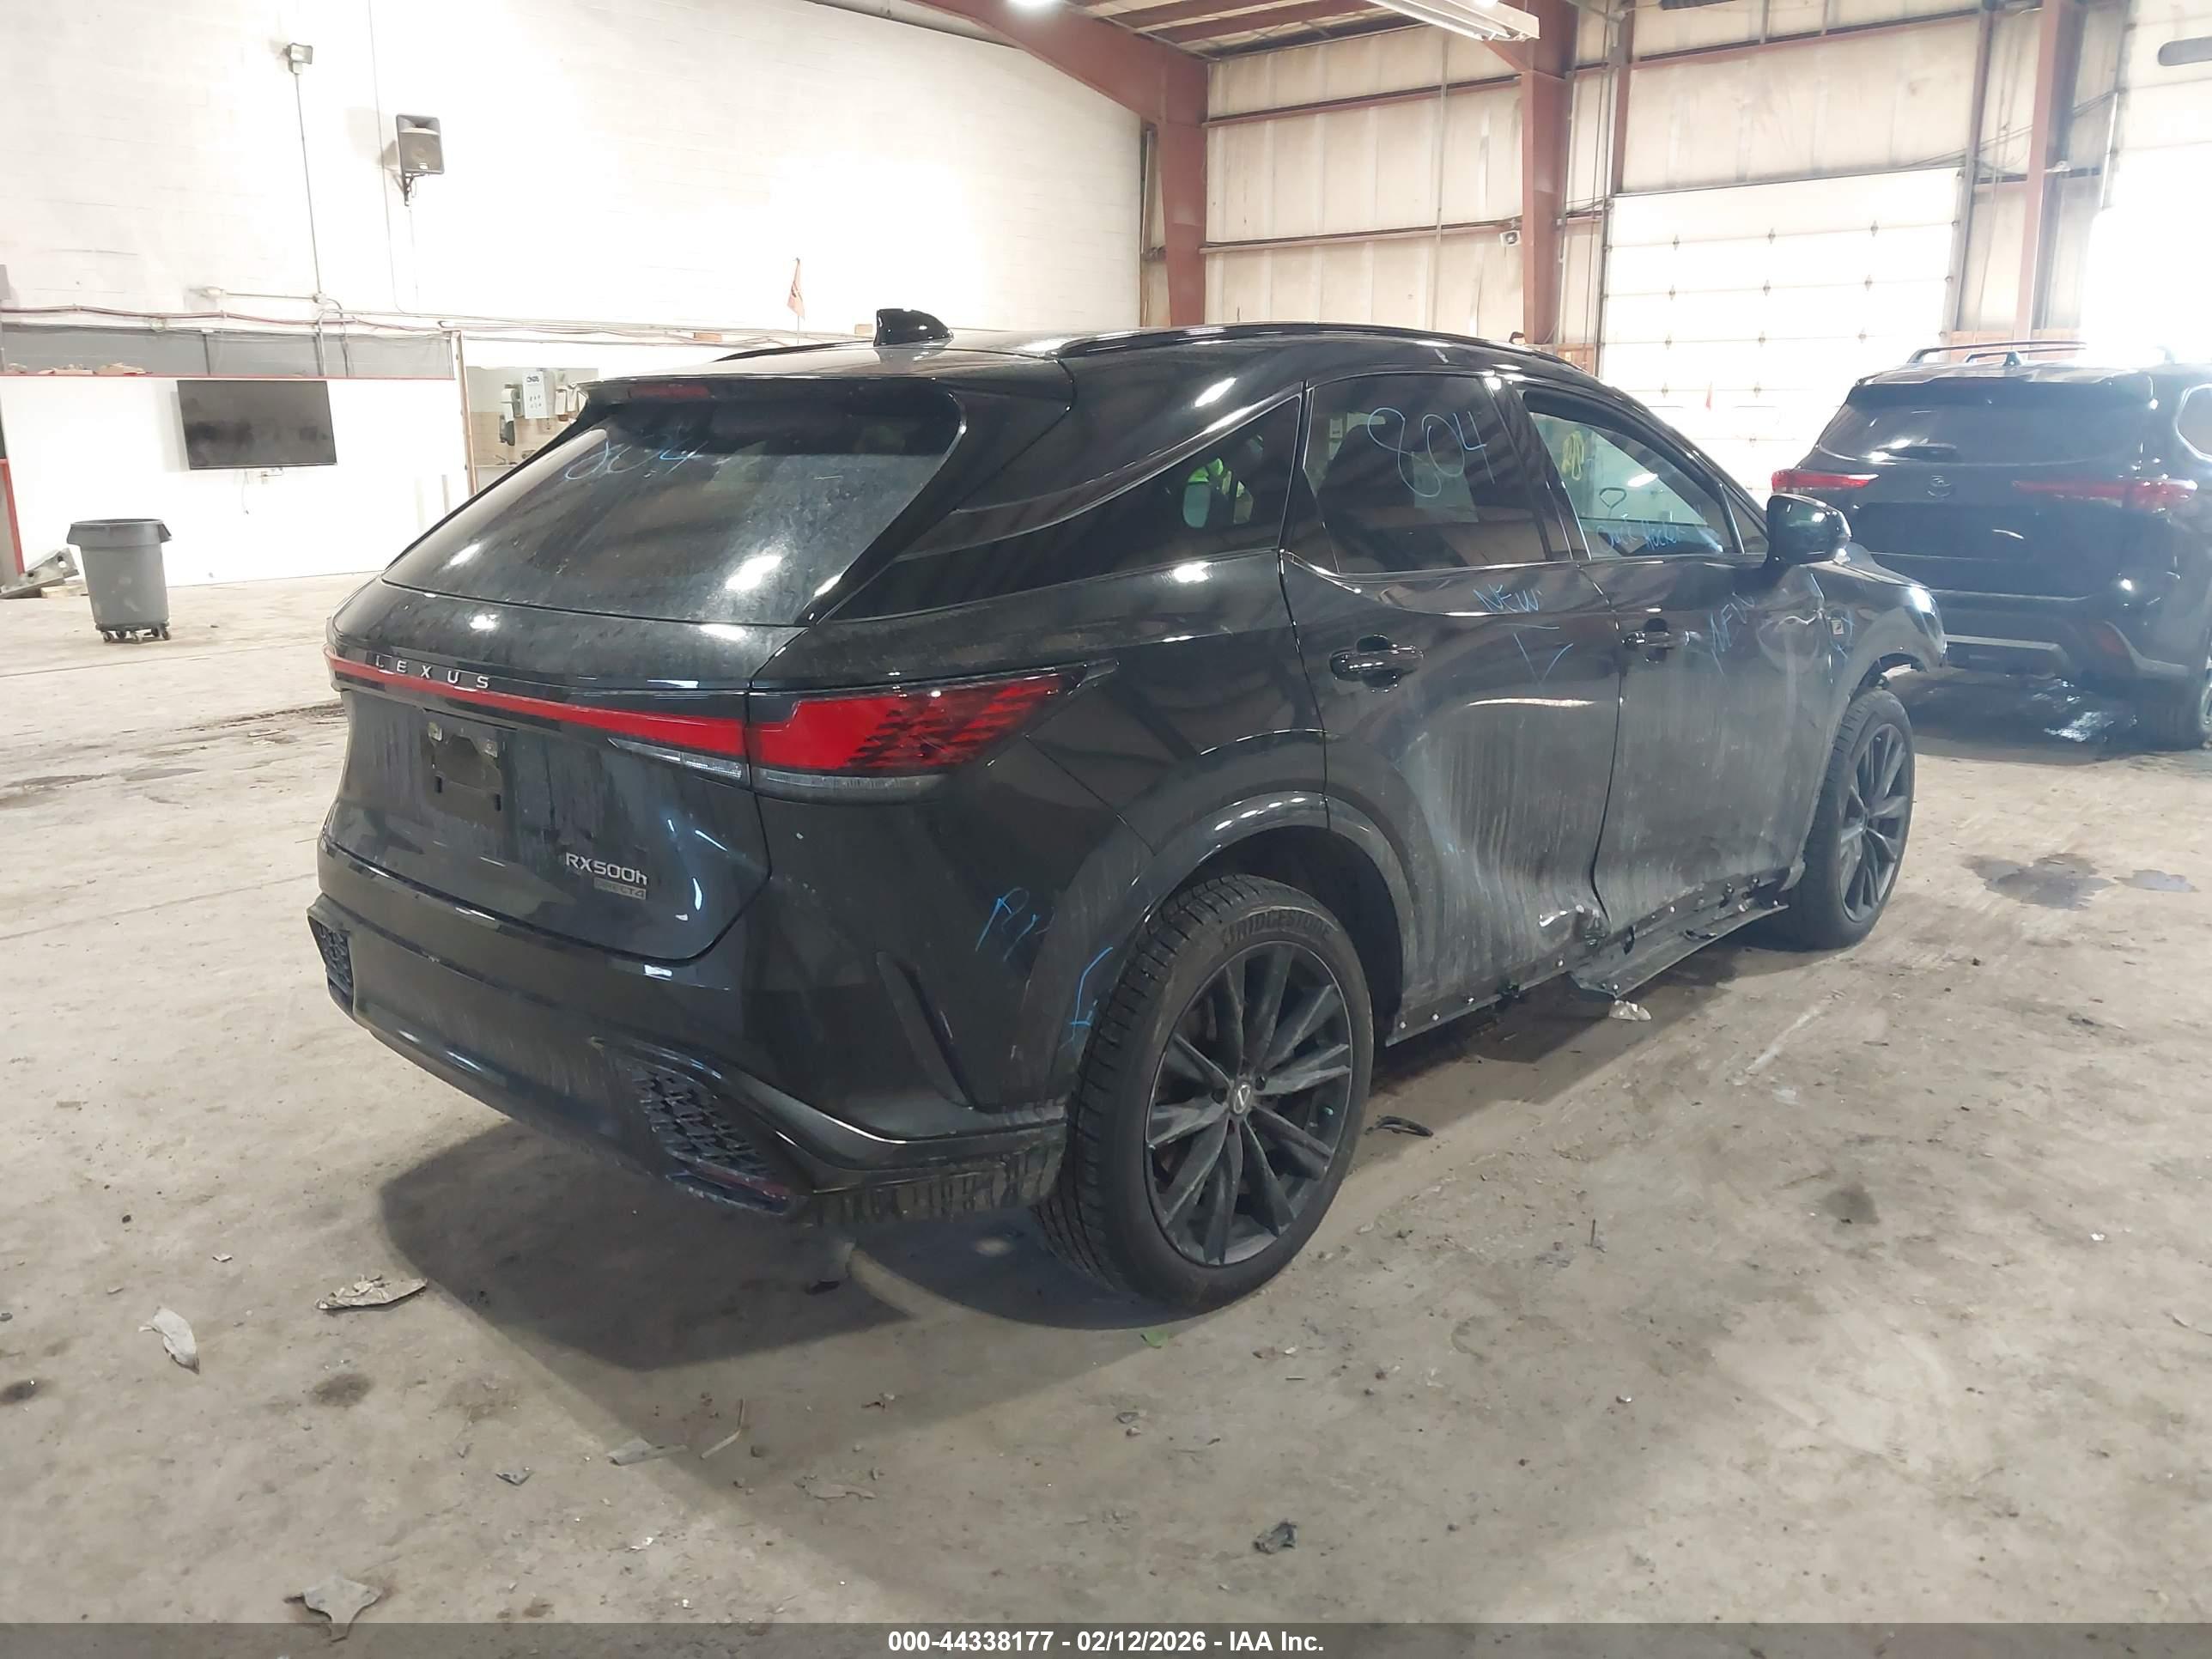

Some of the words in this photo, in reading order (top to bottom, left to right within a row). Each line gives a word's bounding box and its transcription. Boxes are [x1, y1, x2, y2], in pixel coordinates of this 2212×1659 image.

[1367, 407, 1496, 498] 804
[375, 654, 489, 689] LEXUS
[566, 852, 647, 885] RX500h
